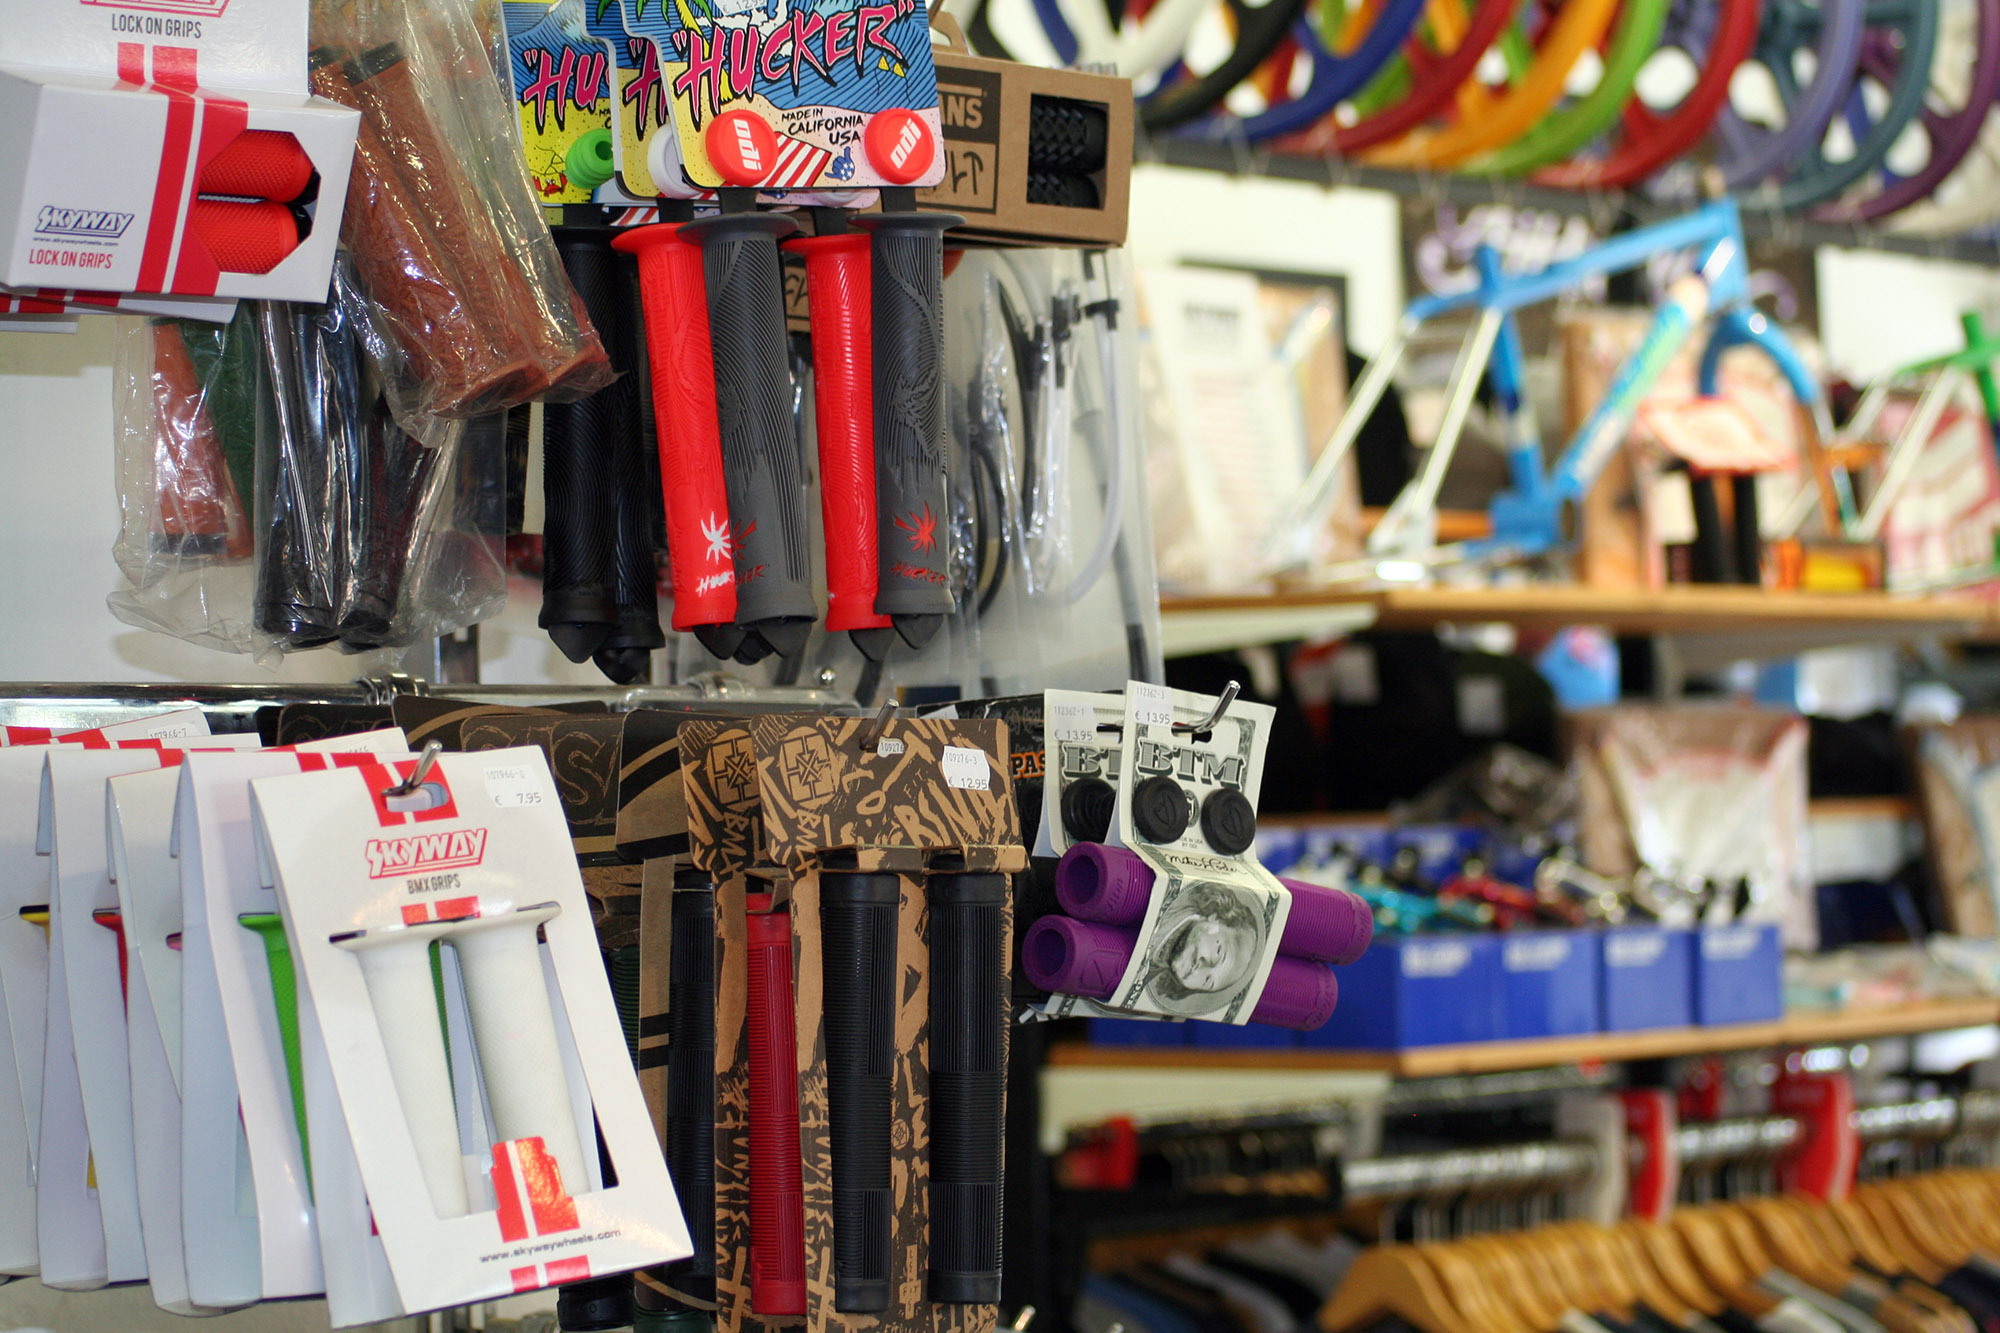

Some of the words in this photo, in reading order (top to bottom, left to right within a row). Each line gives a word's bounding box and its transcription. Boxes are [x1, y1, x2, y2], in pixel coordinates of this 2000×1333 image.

[112, 13, 143, 34] LOCK
[145, 17, 163, 35] ON
[165, 20, 202, 39] GRIPS
[781, 112, 809, 121] MADE
[811, 108, 823, 118] IN
[788, 116, 864, 136] CALIFORNIA
[829, 130, 862, 145] USA
[34, 205, 135, 239] SKYWAY
[29, 249, 60, 266] LOCK
[60, 250, 78, 267] ON
[79, 252, 113, 269] GRIPS
[1146, 712, 1171, 725] 13.95
[1066, 731, 1093, 741] 13.95
[1136, 738, 1247, 788] BTM
[961, 777, 988, 790] 12.95
[516, 791, 542, 804] 7.95
[365, 828, 487, 880] SKYWAY
[407, 878, 430, 894] BMX
[430, 874, 461, 892] GRIPS
[480, 1229, 622, 1264] www.skywaywheels.com
